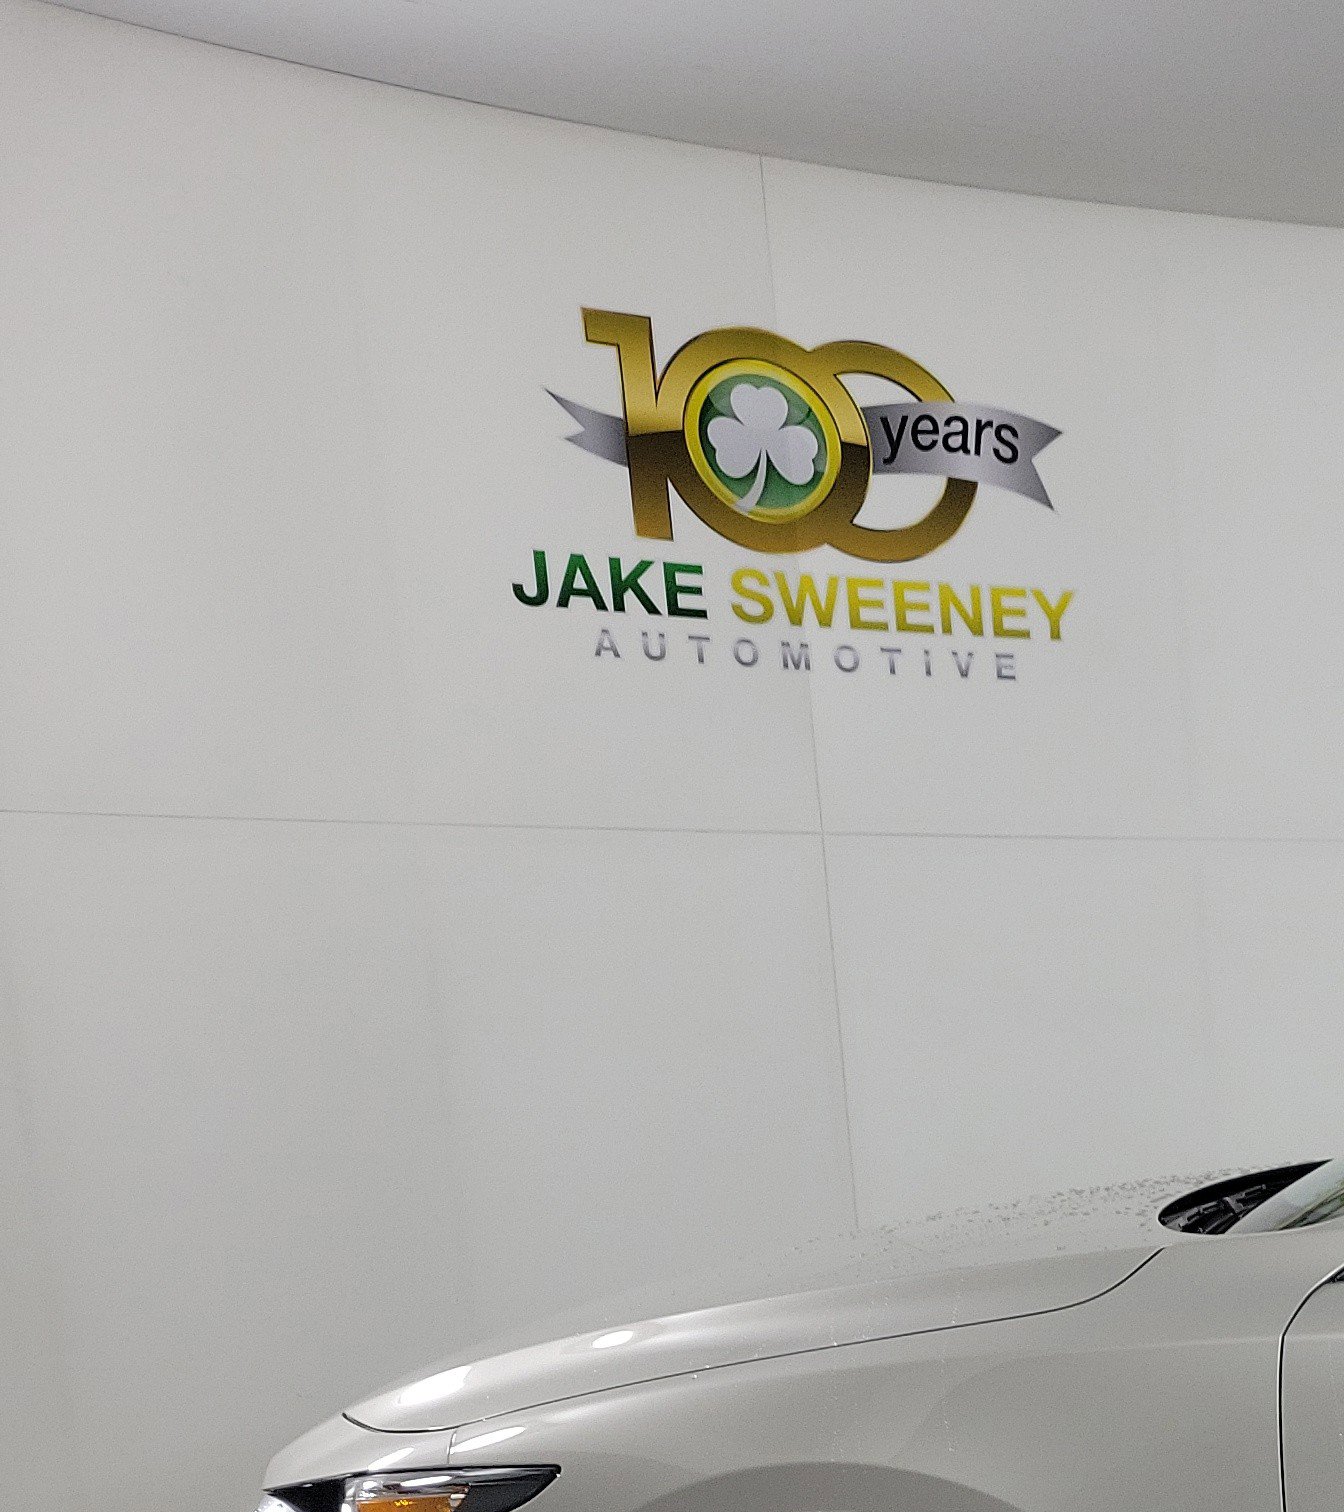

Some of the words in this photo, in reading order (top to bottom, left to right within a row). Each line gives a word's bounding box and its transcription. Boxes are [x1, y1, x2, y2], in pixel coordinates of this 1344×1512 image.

[881, 412, 1020, 465] years
[511, 549, 709, 620] JAKE
[730, 568, 1075, 641] SWEENEY
[594, 628, 1017, 681] AUTOMOTIVE
